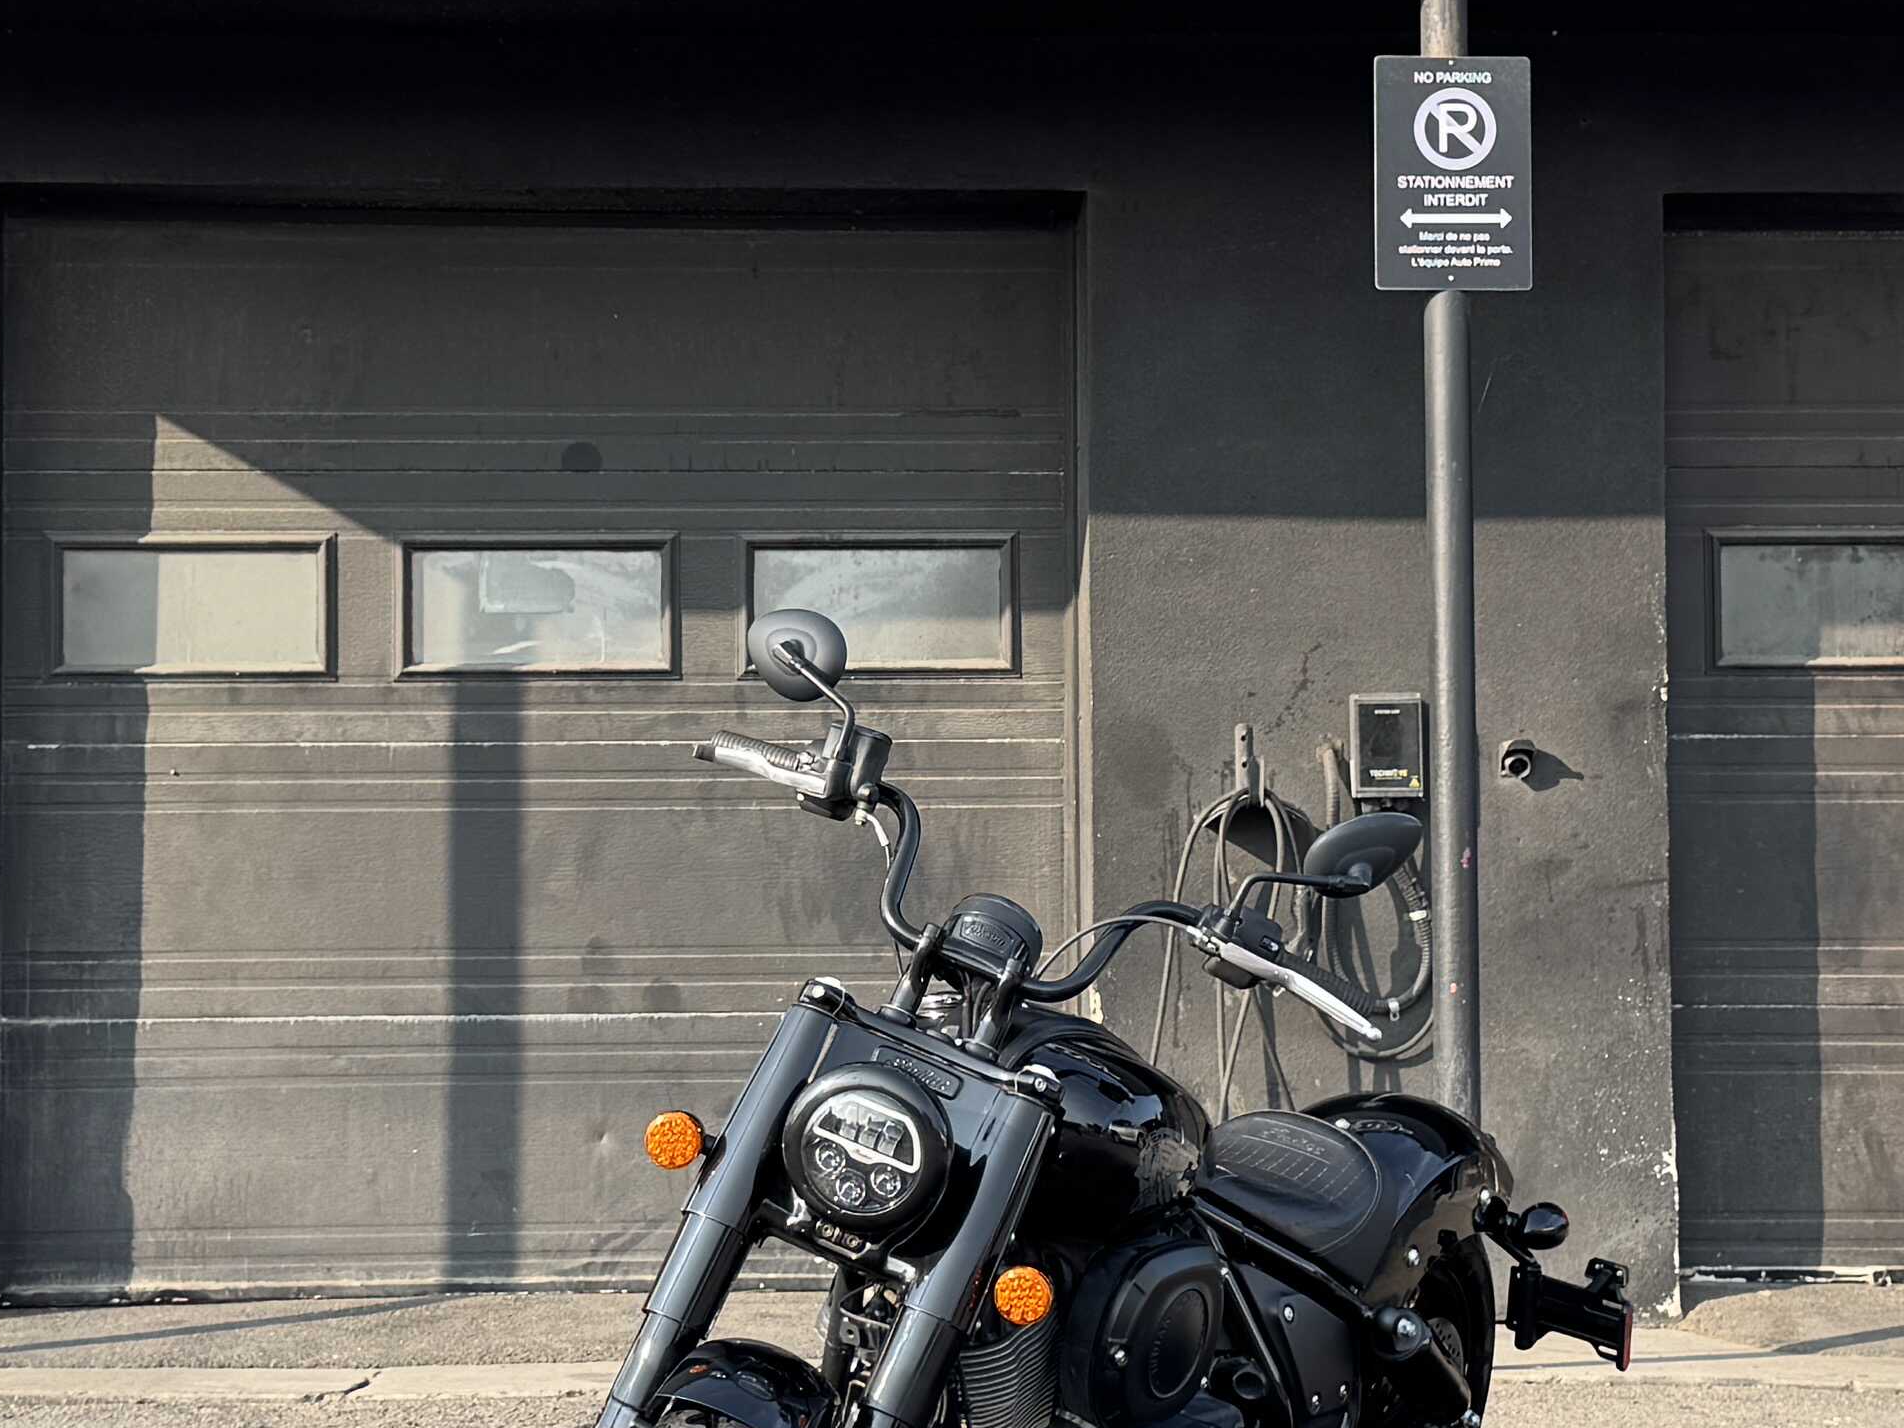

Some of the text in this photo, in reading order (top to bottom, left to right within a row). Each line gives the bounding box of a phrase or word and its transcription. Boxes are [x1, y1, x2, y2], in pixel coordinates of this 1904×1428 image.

[1414, 72, 1492, 84] NO PARKING
[1397, 176, 1514, 188] STATIONNEMENT
[1423, 194, 1488, 206] INTERDIT
